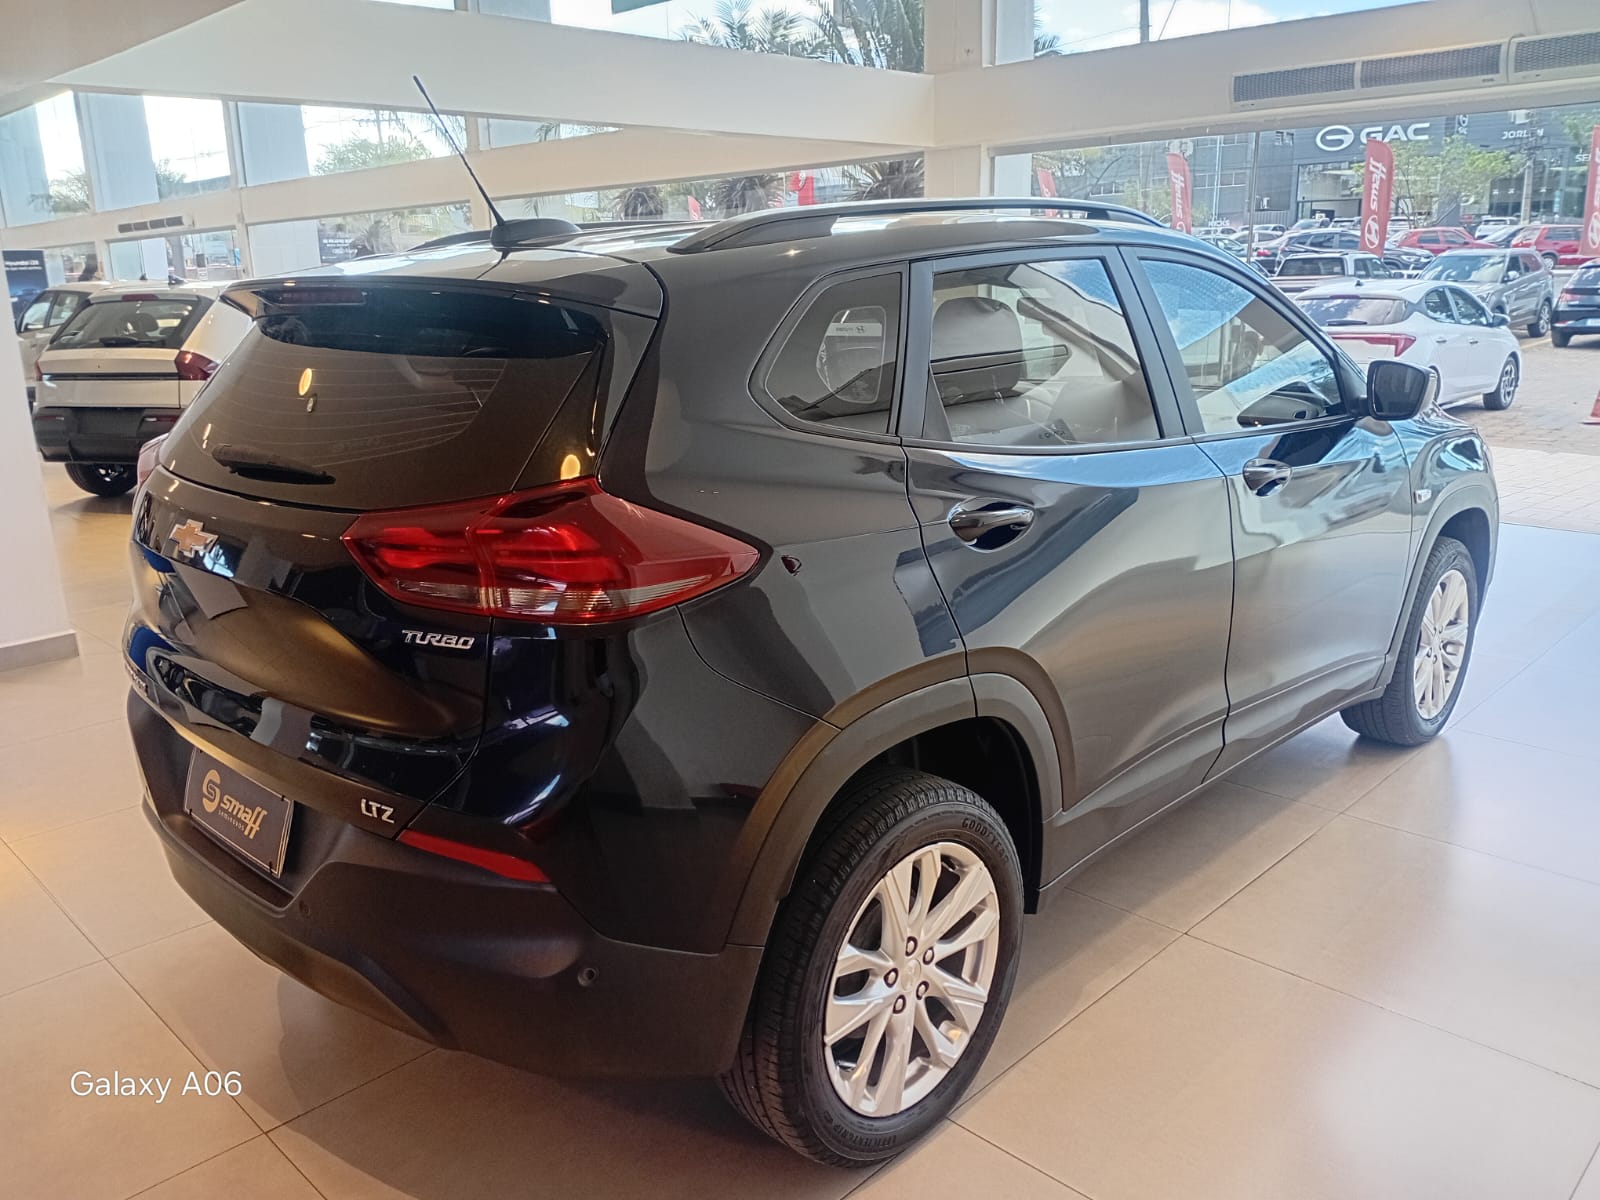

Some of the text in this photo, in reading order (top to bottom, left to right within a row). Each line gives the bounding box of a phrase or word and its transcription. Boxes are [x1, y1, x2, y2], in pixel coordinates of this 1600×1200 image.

[1360, 122, 1430, 145] GAC
[1501, 128, 1544, 140] JORLN
[401, 629, 476, 650] TURBO
[220, 794, 268, 840] smaff
[360, 798, 395, 824] LTZ
